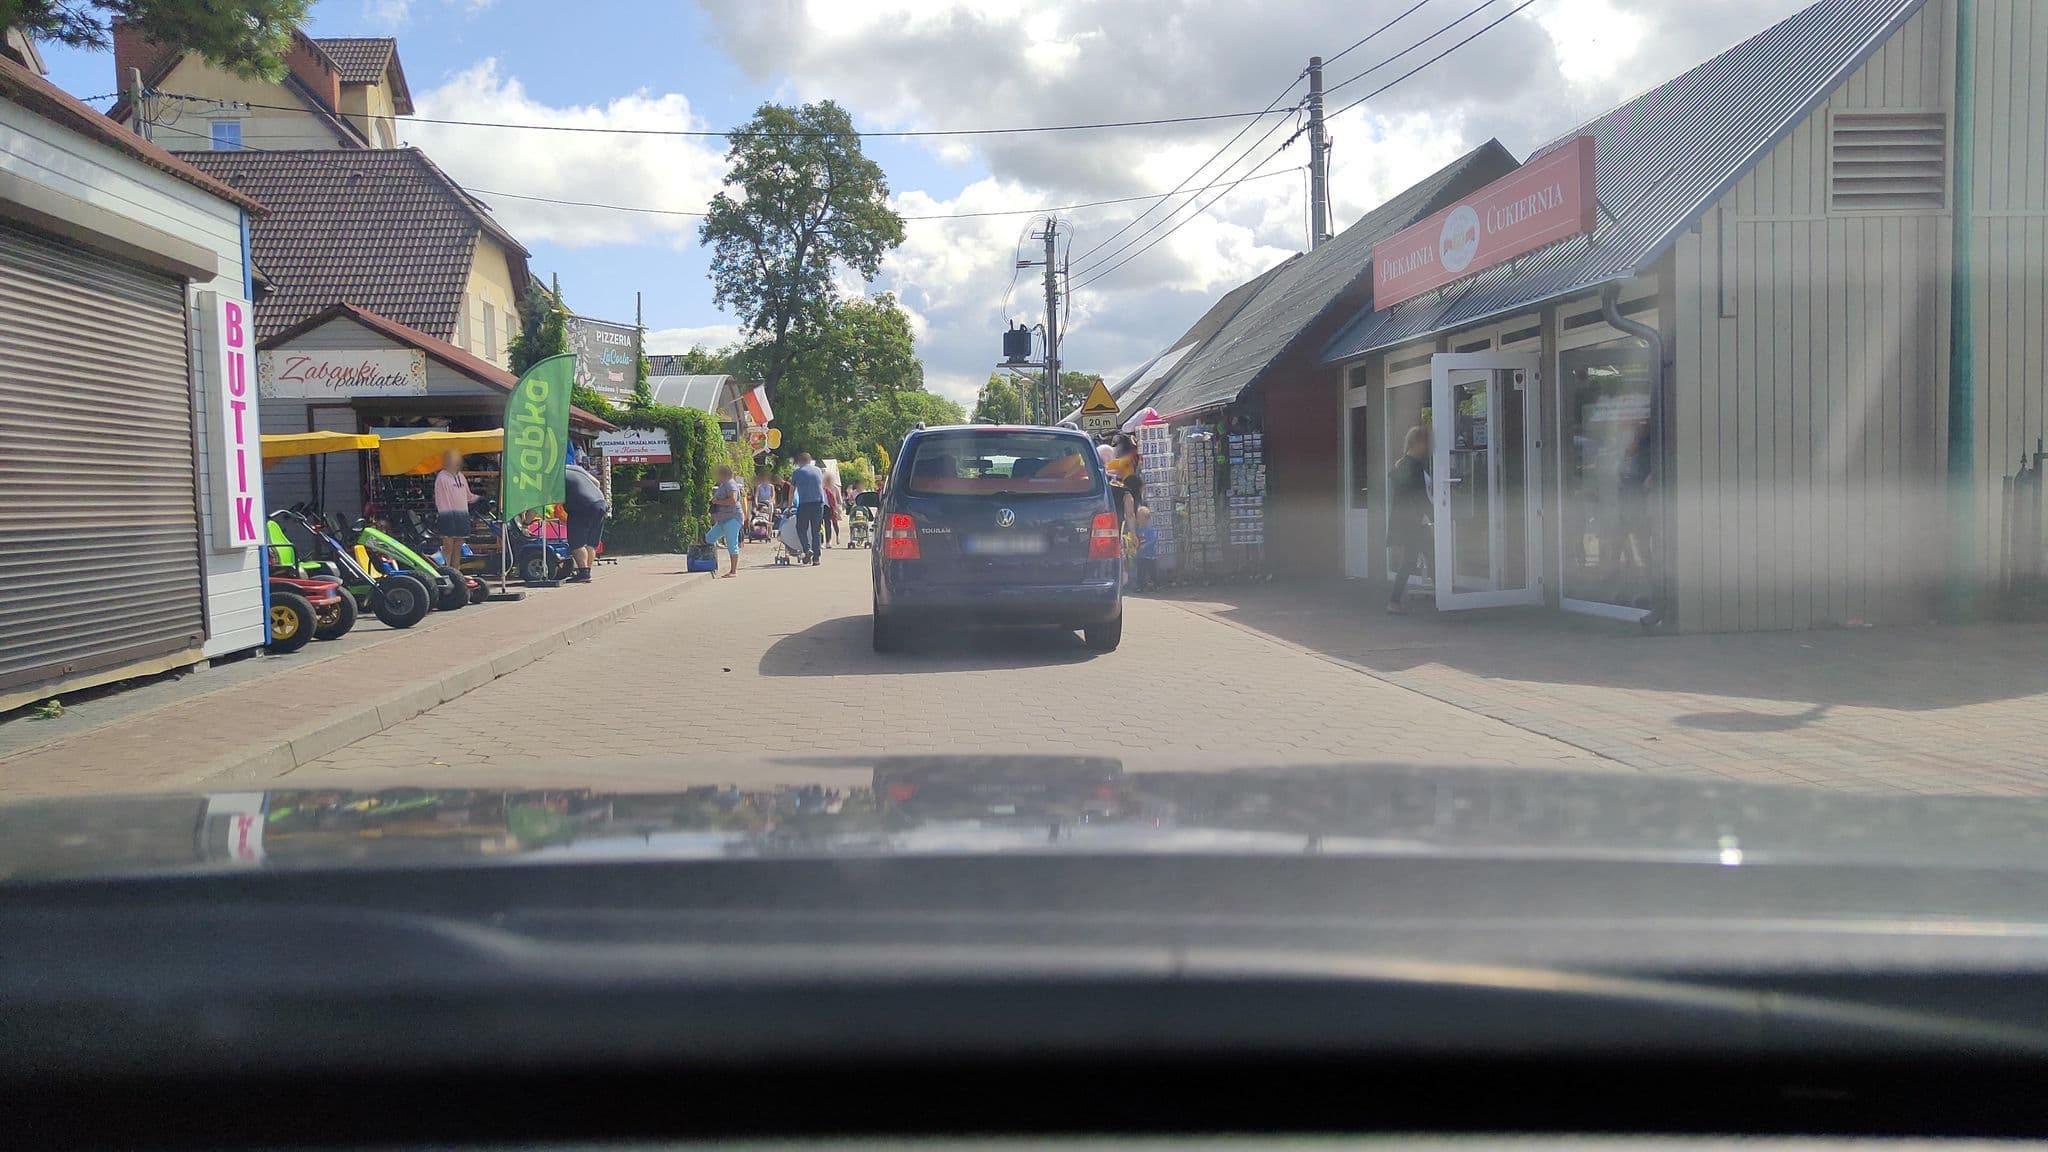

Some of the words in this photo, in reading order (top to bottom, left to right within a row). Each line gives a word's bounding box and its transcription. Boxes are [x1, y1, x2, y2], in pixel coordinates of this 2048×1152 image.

[1486, 183, 1564, 235] CUKIERNIA
[596, 330, 631, 347] PIZZERIA
[279, 356, 381, 383] Zabawki
[334, 373, 409, 391] pamiątki
[225, 301, 257, 541] BUTIK
[1089, 419, 1100, 427] 20
[513, 379, 549, 491] żabka
